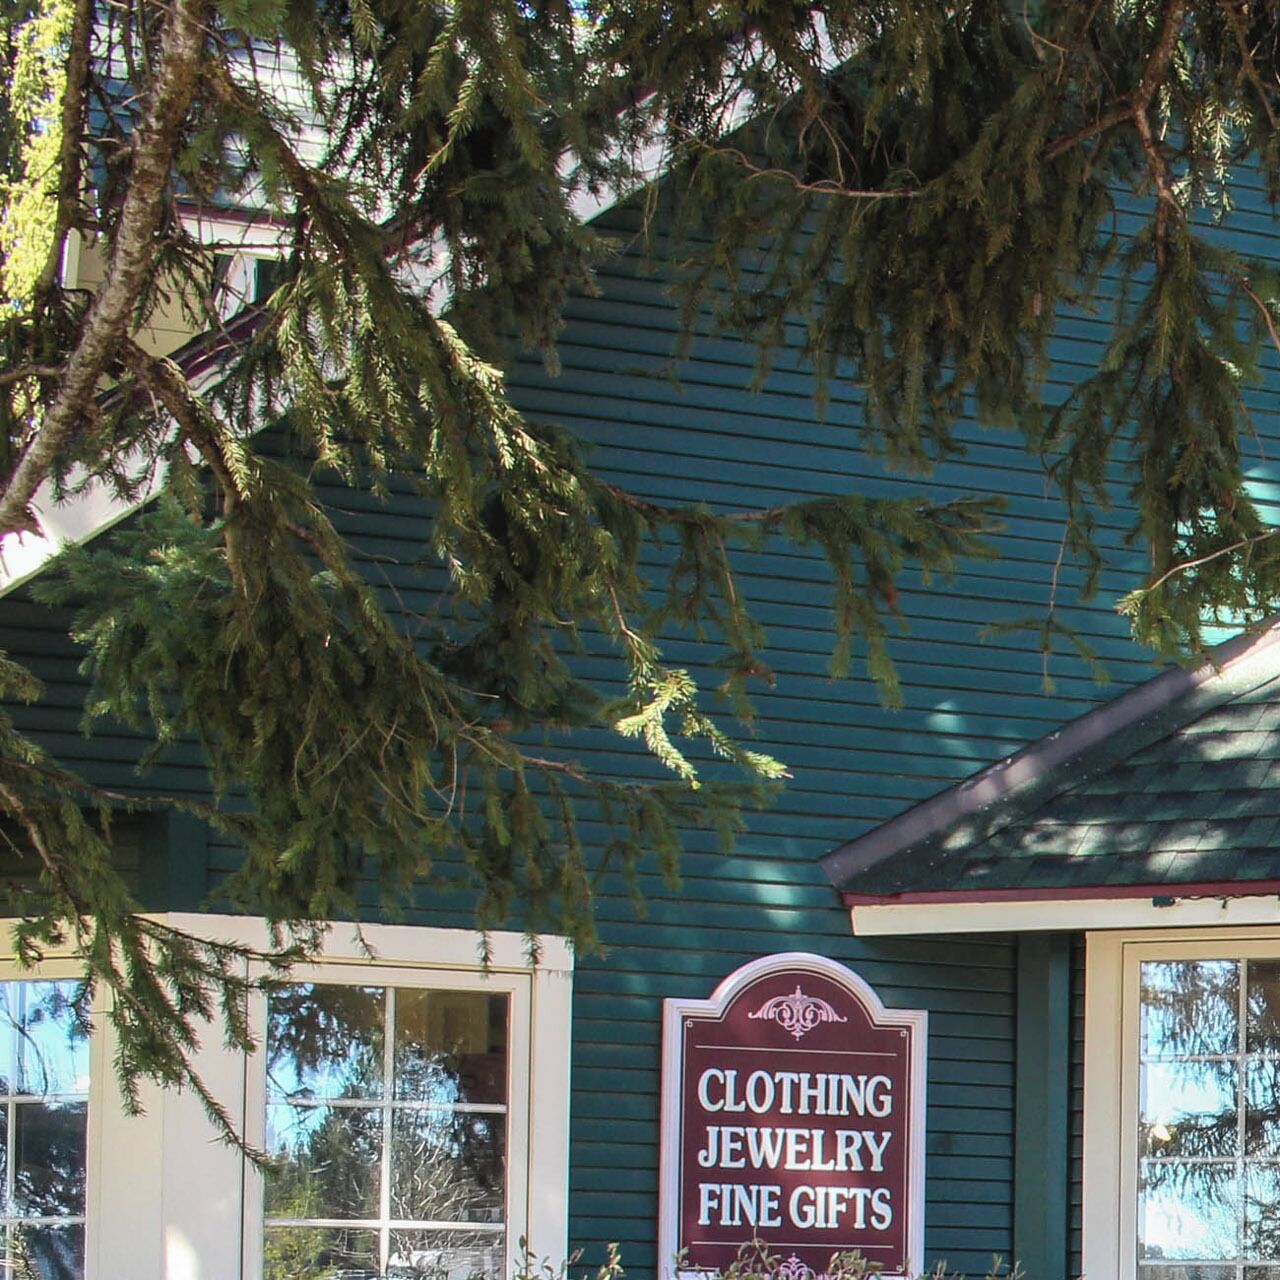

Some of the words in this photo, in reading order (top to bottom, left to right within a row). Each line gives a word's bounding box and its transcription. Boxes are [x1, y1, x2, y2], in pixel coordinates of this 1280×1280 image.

[698, 1068, 893, 1118] CLOTHING
[698, 1126, 892, 1172] JEWELRY
[698, 1184, 782, 1228] FINE
[789, 1186, 893, 1231] GIFTS
